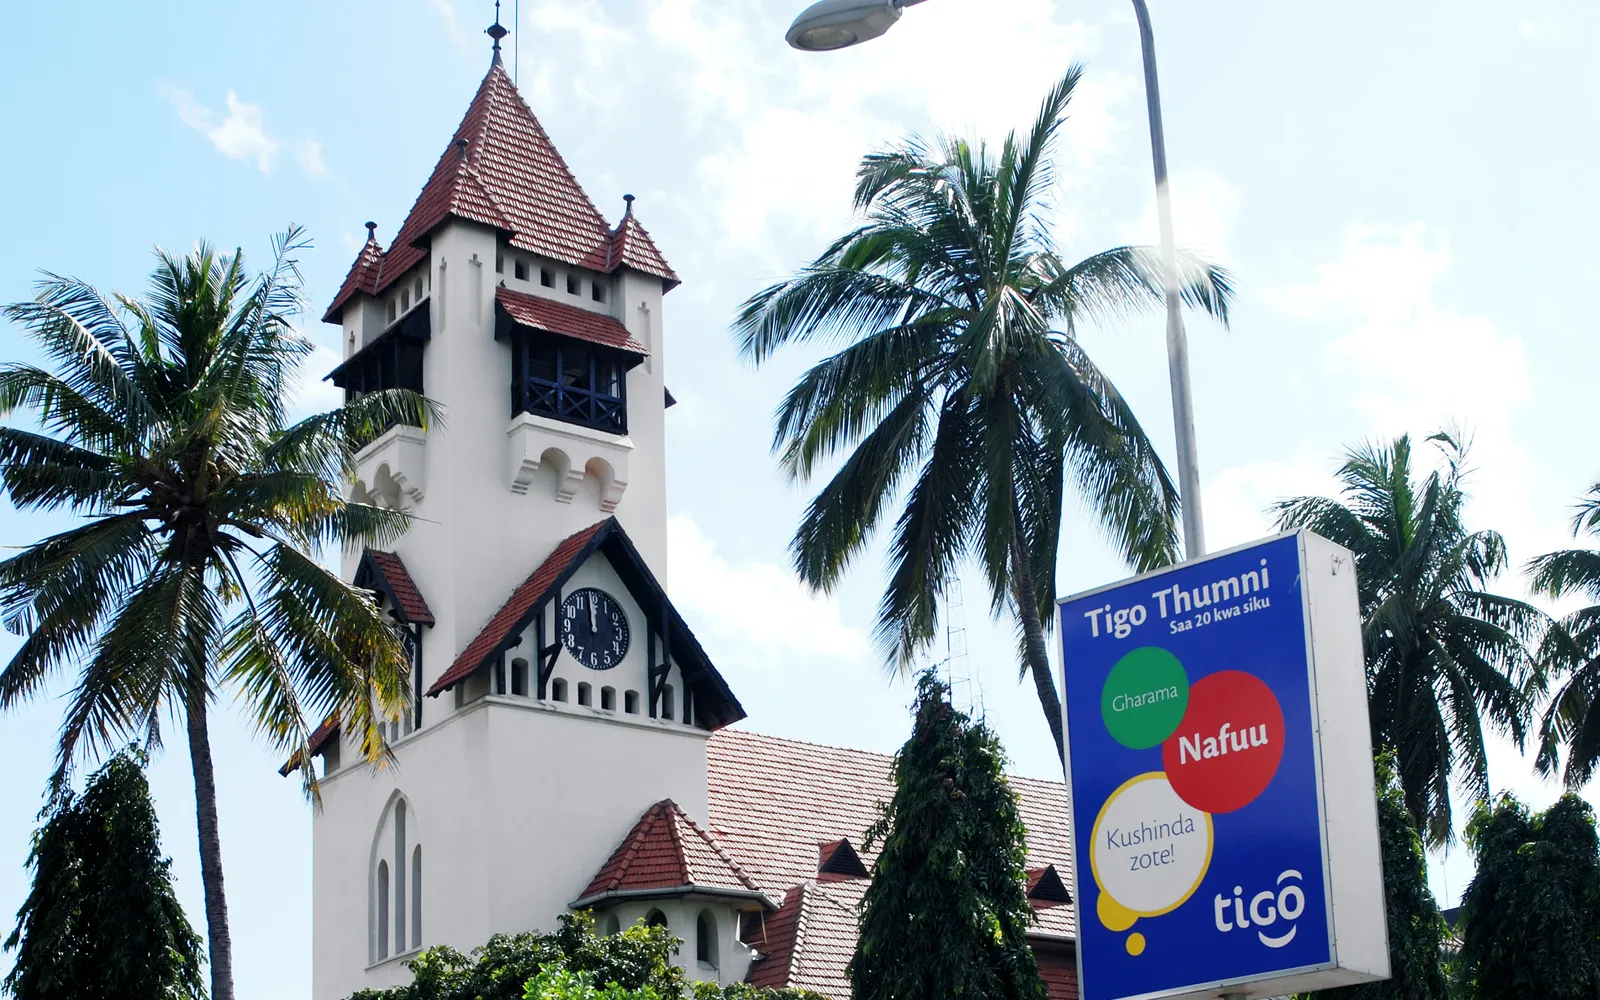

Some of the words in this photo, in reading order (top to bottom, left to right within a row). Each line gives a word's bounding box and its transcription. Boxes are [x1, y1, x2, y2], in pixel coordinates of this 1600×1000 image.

[1084, 604, 1147, 639] Tigo
[1152, 558, 1270, 619] Thumni
[564, 619, 571, 632] 9
[1170, 619, 1193, 635] Saa
[1195, 612, 1212, 628] 20
[1213, 603, 1241, 622] kwa
[1243, 596, 1271, 612] siku
[568, 634, 575, 648] 8
[615, 628, 622, 641] 3
[591, 652, 597, 665] 6
[604, 651, 610, 664] 5
[1112, 684, 1178, 712] Gharama
[1178, 722, 1269, 765] Nafuu
[1106, 813, 1195, 850] Kushinda
[1130, 844, 1175, 871] zote!
